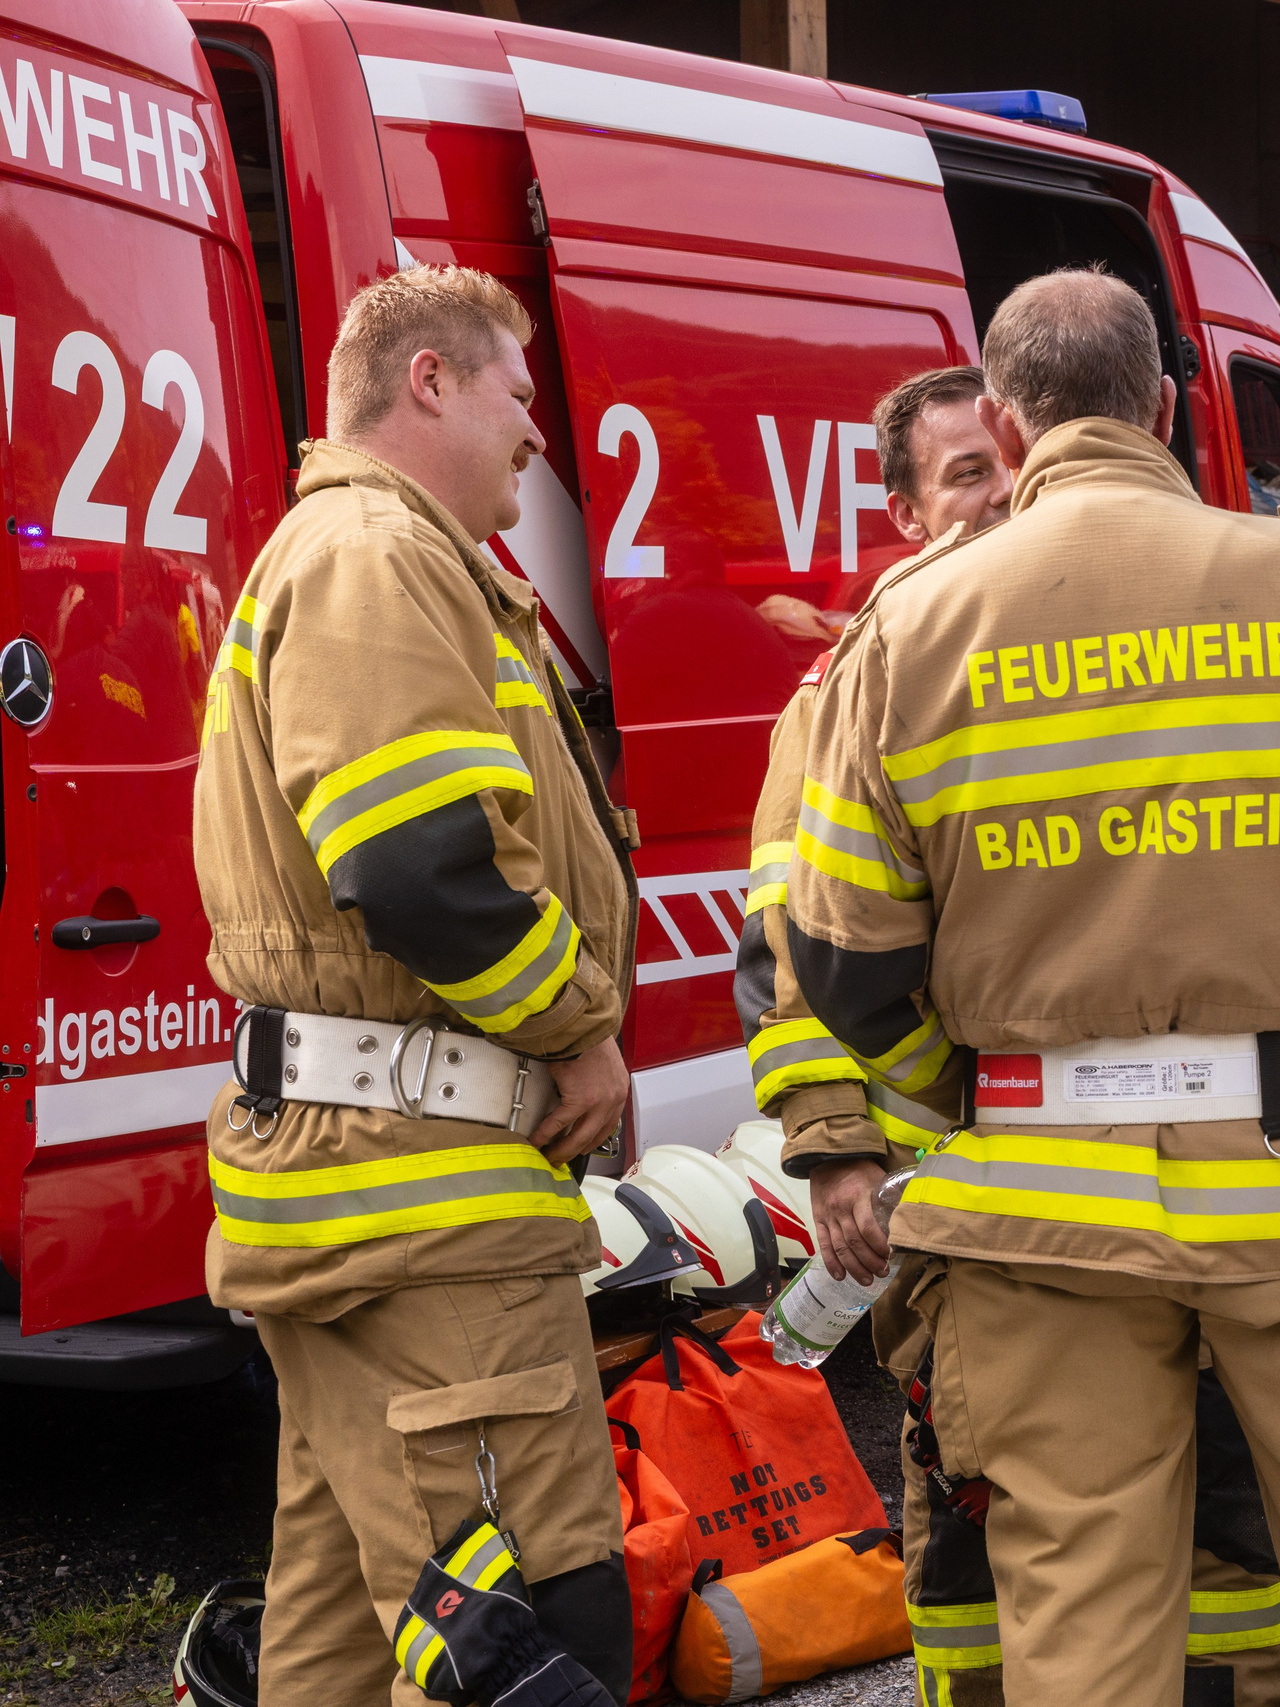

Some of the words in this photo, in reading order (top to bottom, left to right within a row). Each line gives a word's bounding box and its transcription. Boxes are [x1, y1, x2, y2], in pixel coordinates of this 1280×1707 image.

[51, 331, 207, 555] 22
[598, 403, 665, 578] 2
[975, 815, 1081, 871] BAD
[36, 984, 243, 1080] dgastein.
[989, 1075, 1039, 1089] rosenbauer
[1183, 1071, 1206, 1079] Pumpe
[1206, 1069, 1212, 1077] 2
[695, 1474, 827, 1537] RETTUNGS
[729, 1462, 778, 1496] NOT
[751, 1514, 801, 1549] SET
